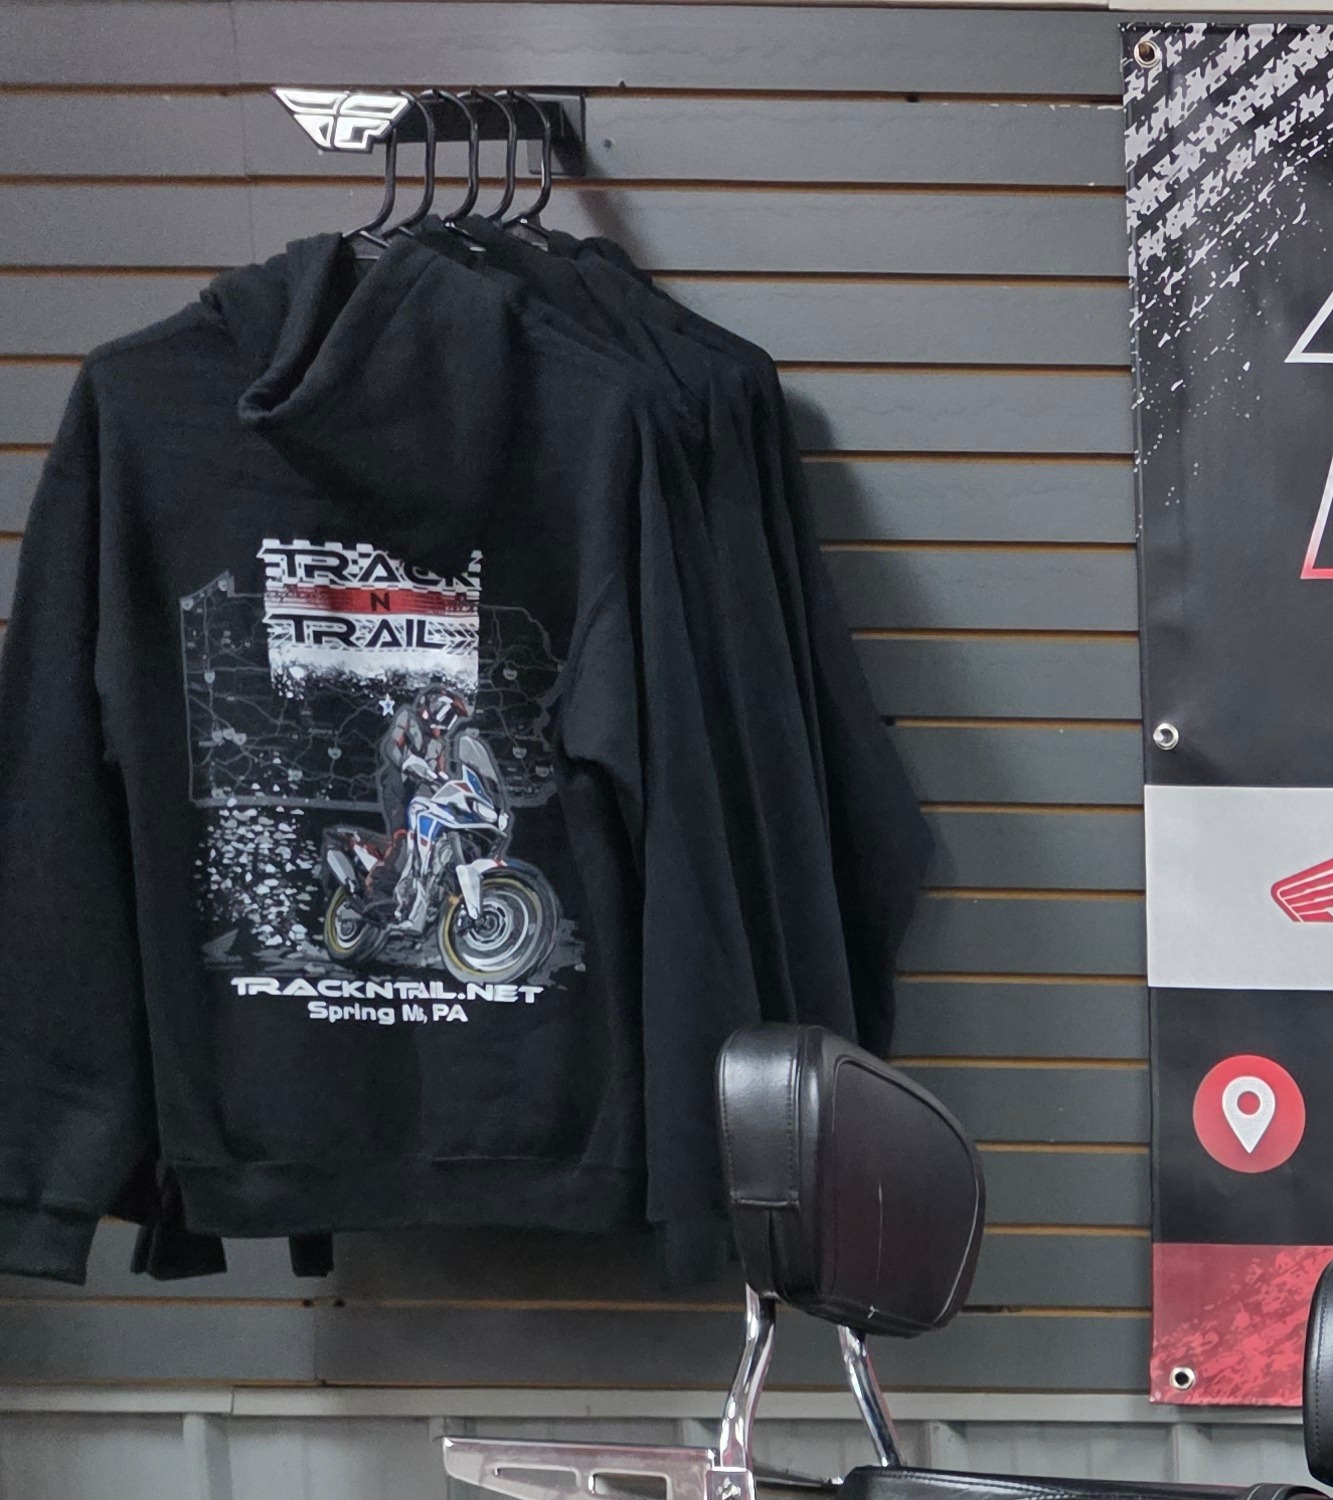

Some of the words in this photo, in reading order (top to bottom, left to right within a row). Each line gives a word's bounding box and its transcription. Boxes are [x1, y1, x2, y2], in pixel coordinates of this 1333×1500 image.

[370, 592, 391, 612] N
[267, 613, 447, 650] TRAIL
[308, 1001, 395, 1025] Spring
[432, 1003, 469, 1022] PA
